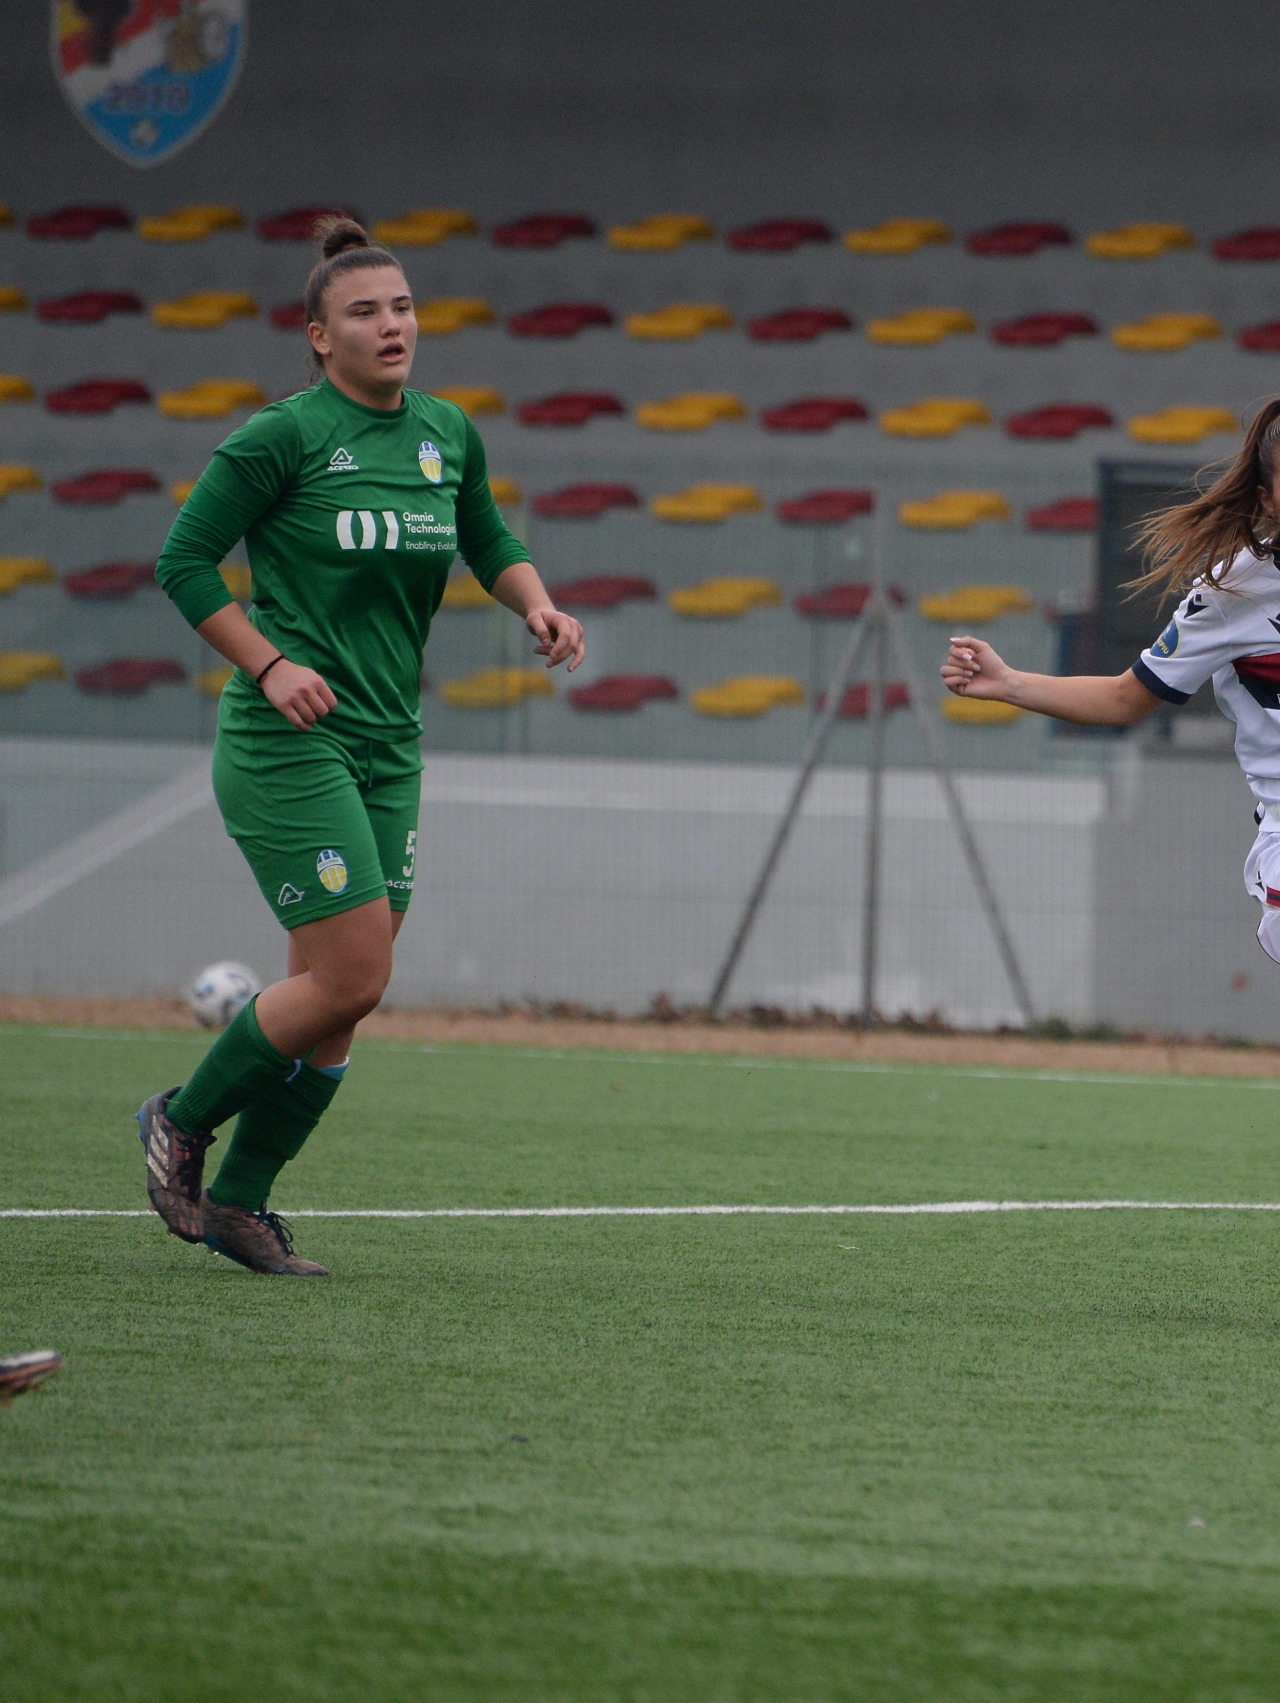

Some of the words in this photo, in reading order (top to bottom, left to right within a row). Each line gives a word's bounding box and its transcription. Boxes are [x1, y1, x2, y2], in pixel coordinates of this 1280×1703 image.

[403, 511, 434, 522] Omnia
[406, 541, 437, 552] Enabling
[402, 830, 416, 877] 5
